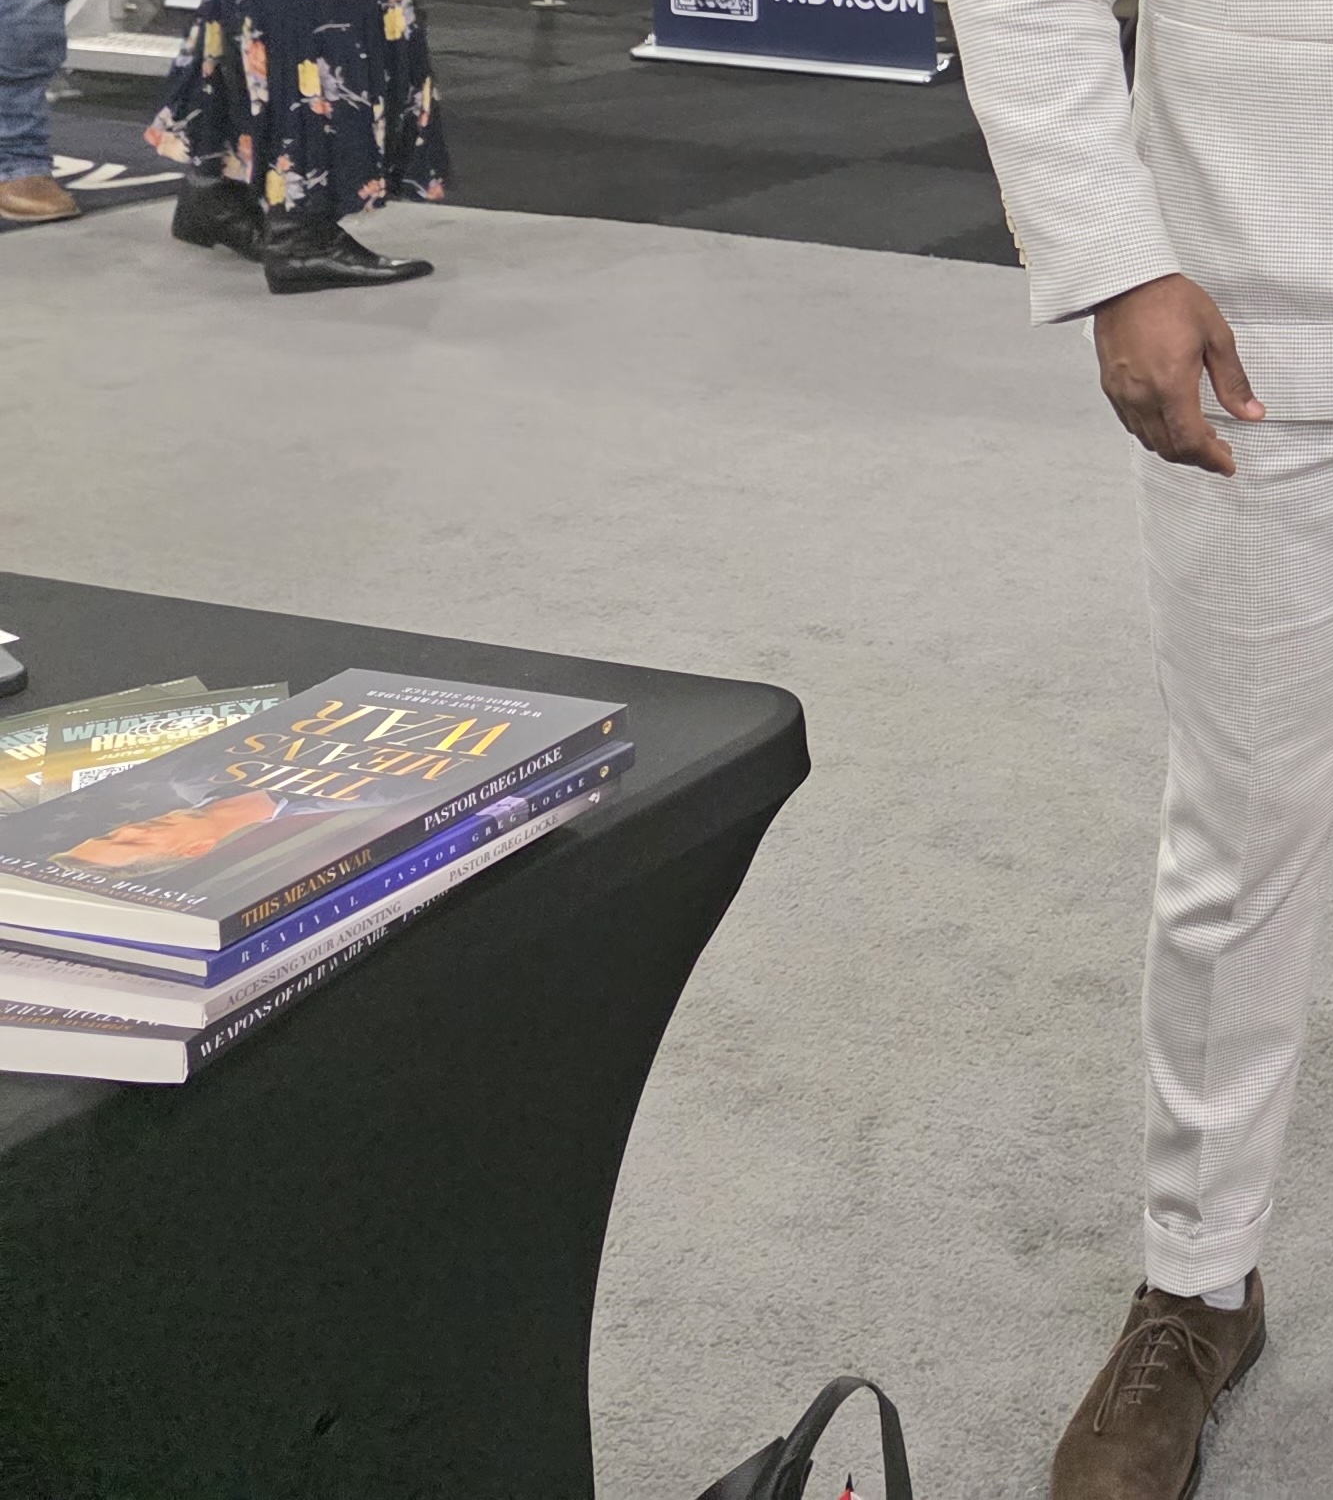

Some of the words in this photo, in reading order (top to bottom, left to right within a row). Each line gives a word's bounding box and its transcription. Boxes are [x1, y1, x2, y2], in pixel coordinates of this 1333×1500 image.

[290, 700, 512, 757] WAR
[208, 760, 383, 801] THIS
[224, 733, 475, 782] MEANS
[0, 854, 38, 869] LO
[241, 900, 280, 928] THIS
[283, 867, 337, 906] MEANS
[338, 849, 372, 876] WAR
[423, 795, 477, 831] PASTOR
[480, 772, 517, 800] GREG
[520, 746, 563, 778] LOCKE
[39, 862, 107, 885] GREG
[111, 880, 209, 906] PASTOR
[241, 896, 358, 964] REVIVAL
[384, 845, 457, 888] PASTOR
[472, 813, 517, 842] GREG
[531, 777, 586, 812] LOCKE
[225, 959, 299, 1009] ACCESSING
[299, 940, 335, 966] YOUR
[336, 901, 402, 946] ANOINTING
[450, 851, 491, 883] PASTOR
[493, 834, 522, 858] GREG
[524, 813, 560, 841] LOCKE
[2, 1002, 55, 1016] GRE
[200, 1000, 272, 1057] WEAPONS
[275, 984, 295, 1007] OF
